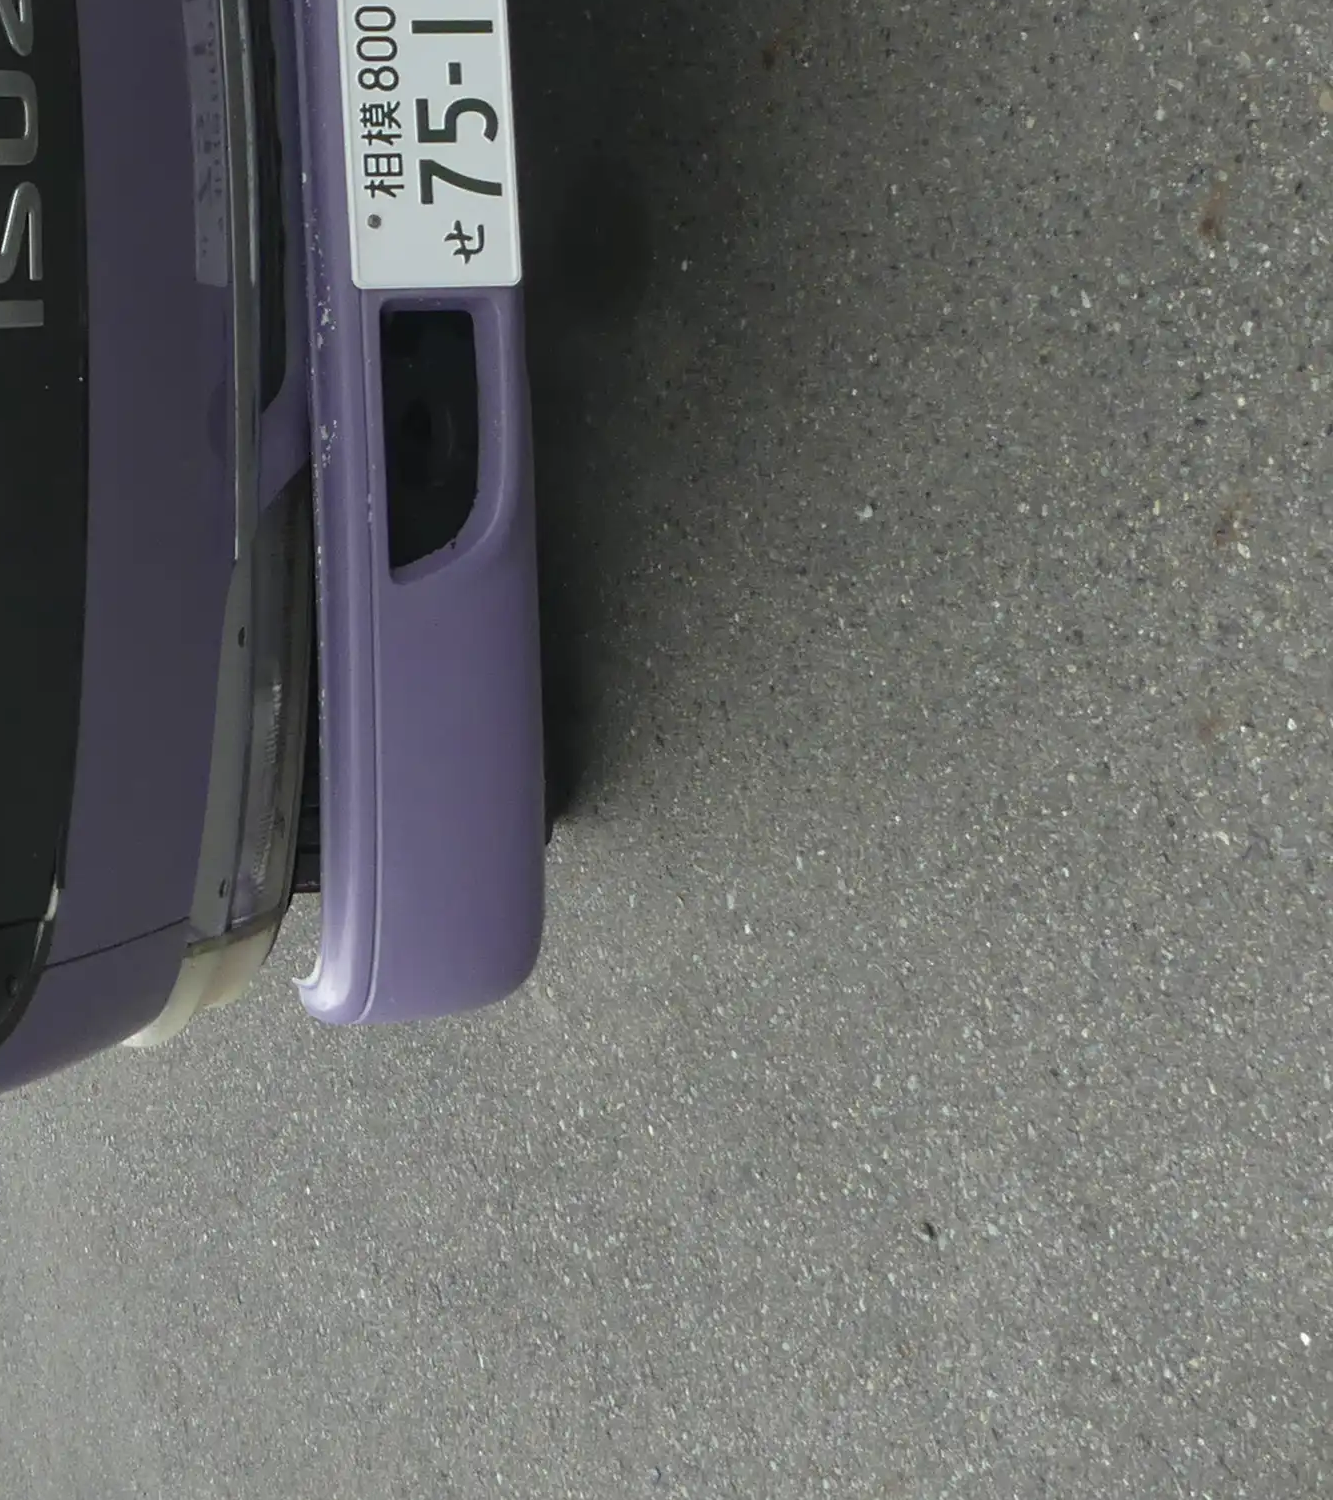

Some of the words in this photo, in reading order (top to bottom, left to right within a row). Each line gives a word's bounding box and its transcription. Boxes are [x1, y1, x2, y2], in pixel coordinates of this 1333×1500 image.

[354, 5, 400, 92] 800
[359, 100, 405, 199] 相模
[444, 219, 485, 265] せ
